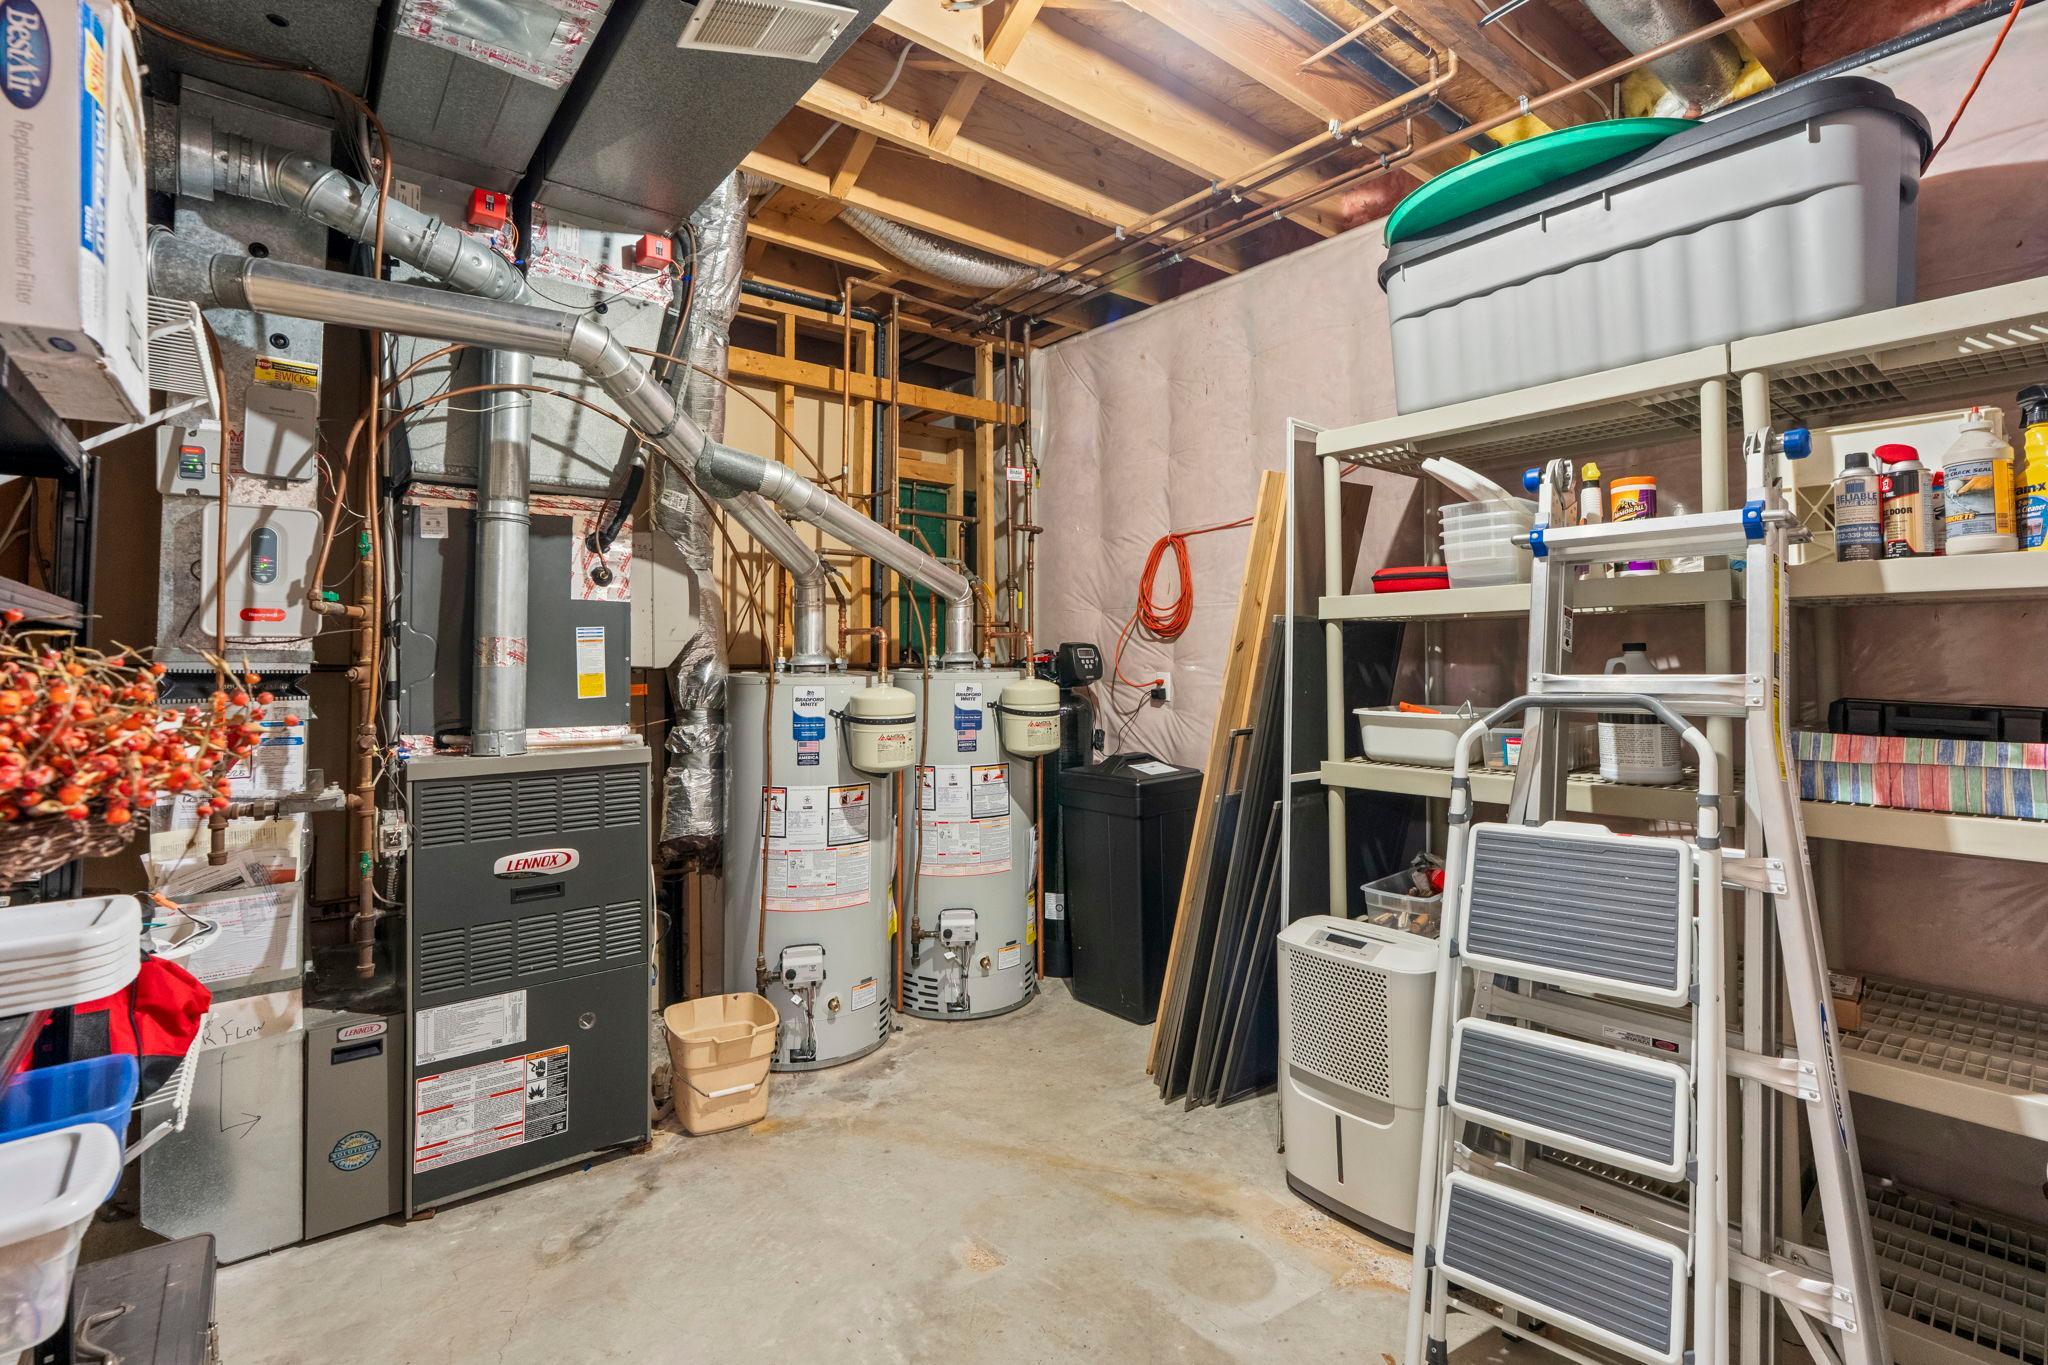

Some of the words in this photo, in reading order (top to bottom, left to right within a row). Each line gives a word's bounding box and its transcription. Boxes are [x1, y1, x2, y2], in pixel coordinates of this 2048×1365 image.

[6, 5, 41, 98] BestAir
[9, 119, 35, 202] Replacement
[15, 203, 35, 270] Humidifier
[16, 272, 36, 306] Filter
[1836, 492, 1877, 502] RELIABLE
[1890, 506, 1913, 516] DOOR
[506, 854, 559, 872] LENNOX
[344, 1025, 376, 1038] LENNOX
